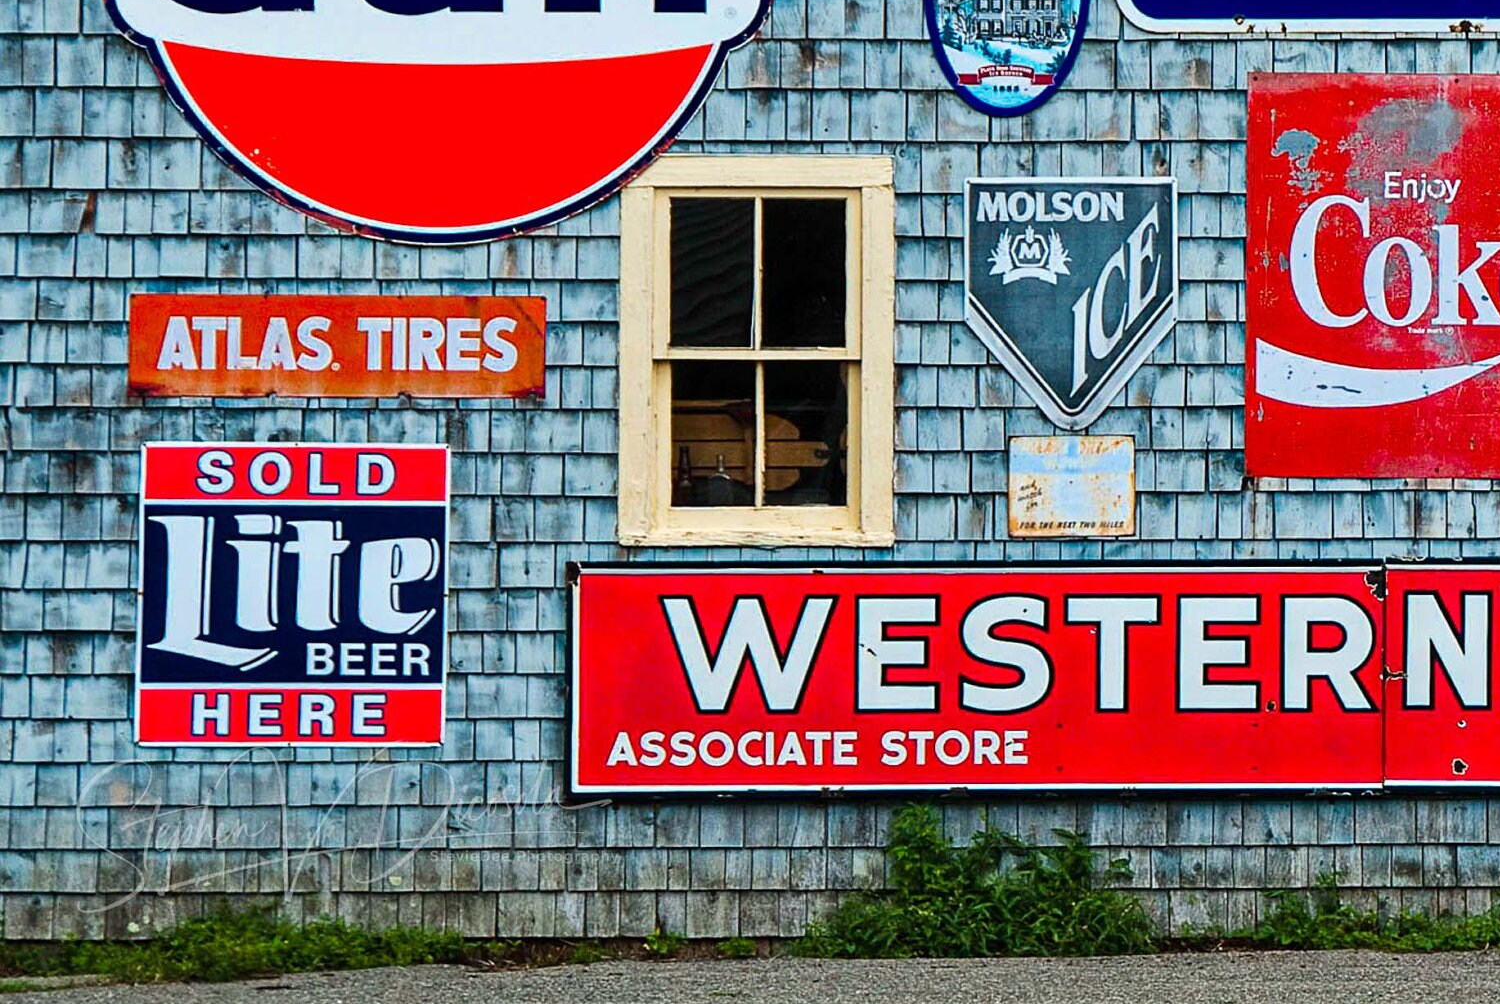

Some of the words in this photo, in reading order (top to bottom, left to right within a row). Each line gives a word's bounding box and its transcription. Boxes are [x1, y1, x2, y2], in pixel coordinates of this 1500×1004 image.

[977, 191, 1126, 223] MOLSON
[1383, 171, 1461, 204] Enjoy
[1019, 242, 1042, 260] M
[1069, 202, 1162, 398] ICE
[357, 317, 519, 373] TIRES
[195, 450, 397, 496] SOLD
[147, 513, 440, 672] Lite
[306, 642, 432, 677] BEER
[660, 593, 1493, 714] WESTERN
[191, 693, 388, 737] HERE
[606, 731, 858, 767] ASSOCIATE
[880, 731, 1029, 766] STORE
